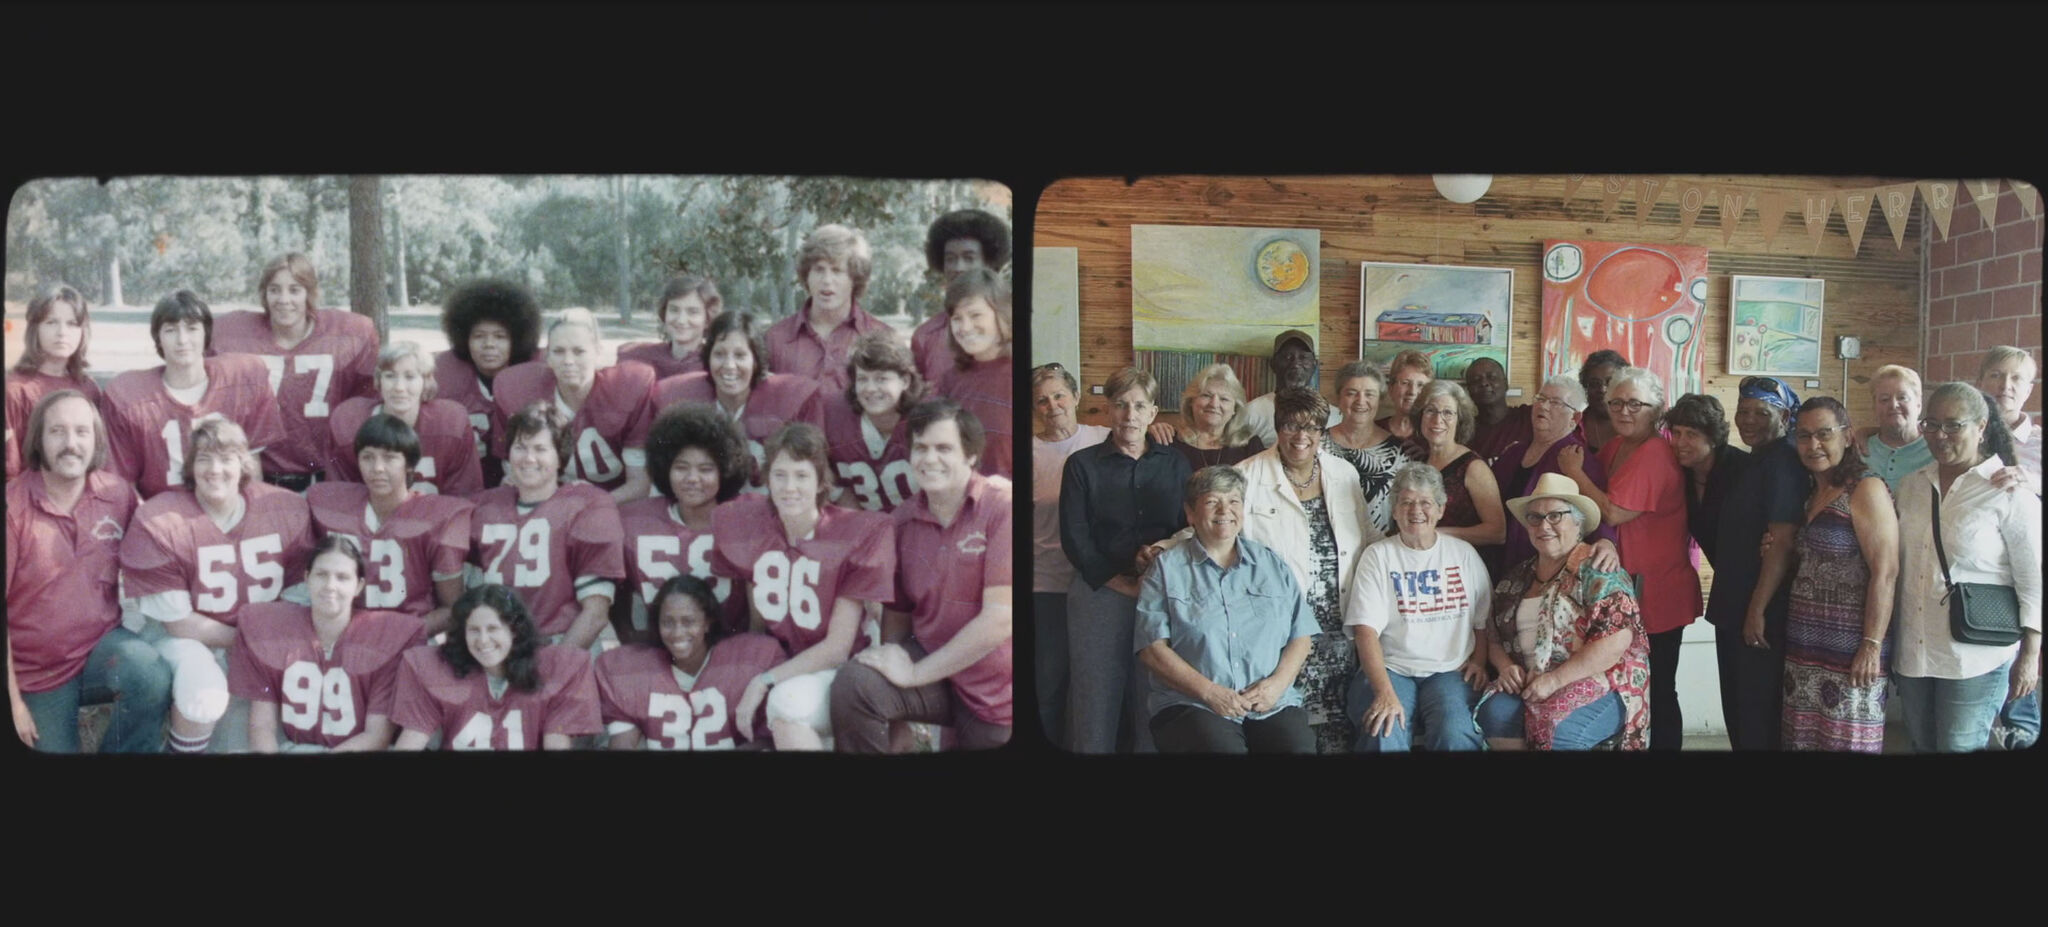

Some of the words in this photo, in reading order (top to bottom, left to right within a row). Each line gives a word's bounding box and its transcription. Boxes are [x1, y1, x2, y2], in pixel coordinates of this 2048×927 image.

[1570, 174, 1742, 219] STON
[1806, 181, 2031, 224] HERRI
[830, 459, 921, 512] 30
[197, 533, 284, 613] 55
[481, 518, 550, 587] 79
[753, 550, 822, 630] 86
[1390, 566, 1469, 616] USA
[282, 660, 357, 736] 99
[452, 710, 525, 751] 41
[647, 686, 736, 751] 32
